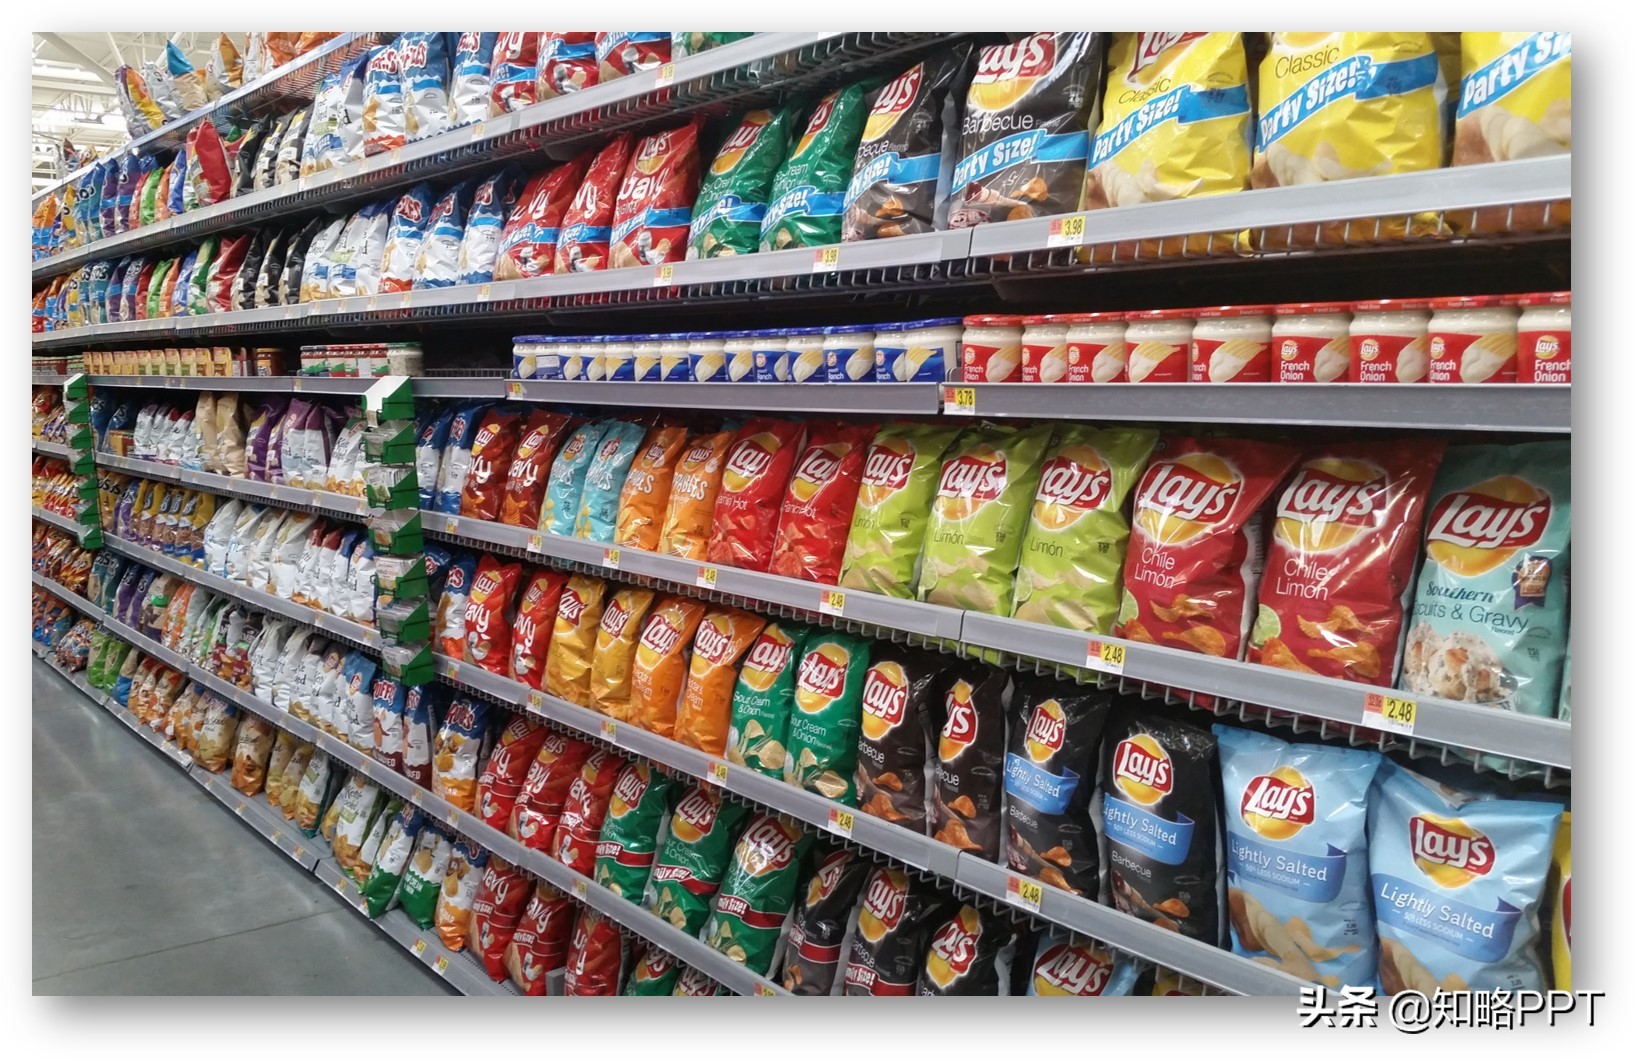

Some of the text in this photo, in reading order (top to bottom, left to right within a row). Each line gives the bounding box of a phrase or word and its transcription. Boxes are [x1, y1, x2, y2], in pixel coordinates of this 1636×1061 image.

[1274, 46, 1340, 80] Classic
[1117, 77, 1171, 105] Classic
[1462, 51, 1528, 111] Party
[1260, 61, 1358, 148] Party Size!
[962, 112, 1034, 136] Barbecue
[1091, 91, 1182, 164] Party Size!
[952, 132, 1038, 190] Party Size!
[828, 370, 845, 382] Ranch
[964, 363, 984, 375] French
[1022, 364, 1038, 375] rench
[1068, 364, 1089, 374] French
[1068, 373, 1085, 382] Onion
[1280, 360, 1310, 372] French
[1280, 370, 1304, 382] Onion
[1360, 360, 1392, 372] French
[1360, 371, 1386, 382] Onion
[1430, 360, 1457, 372] French
[1430, 371, 1450, 382] Onion
[1534, 371, 1566, 382] Onion
[508, 457, 539, 488] avy
[938, 457, 1005, 498] Lay's
[1035, 464, 1110, 507] Lay's
[1138, 464, 1238, 521] Lay's
[1276, 469, 1382, 523] Lay's
[1427, 494, 1546, 549] Lay's
[934, 527, 964, 545] Limón
[1029, 536, 1064, 558] Limón
[1141, 547, 1176, 571] Chile
[1283, 557, 1329, 580] Chile
[1134, 564, 1176, 589] Limón
[1275, 576, 1329, 602] Limón
[1425, 580, 1496, 603] Southern
[465, 602, 491, 633] avy
[1450, 602, 1464, 621] &
[1469, 605, 1530, 634] Gravy
[733, 691, 750, 702] Sour
[862, 669, 906, 720] Lay's
[797, 730, 817, 745] Onion
[801, 718, 827, 737] Cream
[1027, 708, 1064, 749] Lay's
[1006, 759, 1031, 786] Lightly
[1033, 774, 1061, 798] Salted
[1116, 743, 1171, 787] Lay's
[1244, 776, 1312, 820] Lay's
[1141, 818, 1177, 846] Salted
[1413, 818, 1491, 868] Lay's
[1111, 850, 1152, 878] Barbecue
[1231, 839, 1328, 882] Lightly Salted
[484, 865, 509, 905] avy
[1272, 872, 1301, 886] SODIUM
[1380, 882, 1436, 917] Lightly
[1438, 904, 1496, 940] Salted
[1415, 915, 1432, 929] LESS
[1431, 920, 1464, 940] SODIUM
